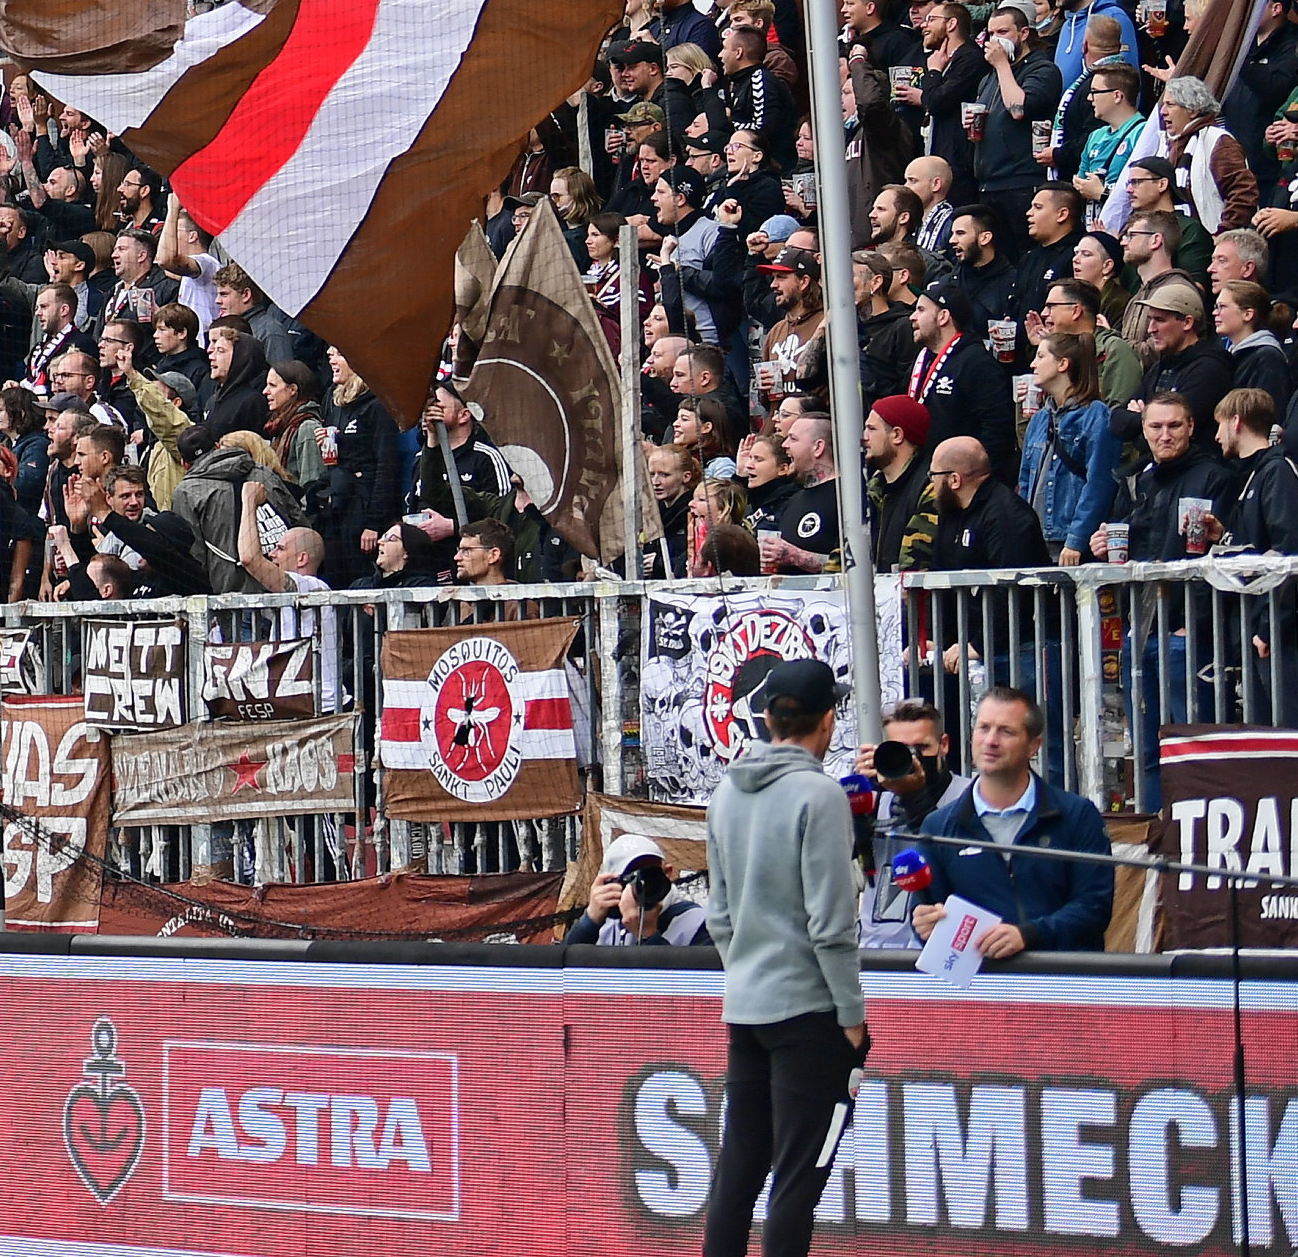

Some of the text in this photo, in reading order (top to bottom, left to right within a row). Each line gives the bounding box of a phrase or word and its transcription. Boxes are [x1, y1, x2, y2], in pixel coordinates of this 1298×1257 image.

[87, 627, 182, 674] METT
[742, 611, 813, 662] DEZIB
[203, 639, 313, 701] GNZ
[428, 641, 521, 693] MOSQUITOS
[85, 675, 182, 725] CREW
[429, 746, 522, 799] SANKT PAULI
[943, 914, 979, 971] sky sport
[187, 1086, 432, 1172] ASTRA
[635, 1070, 1298, 1250] SHMECK
